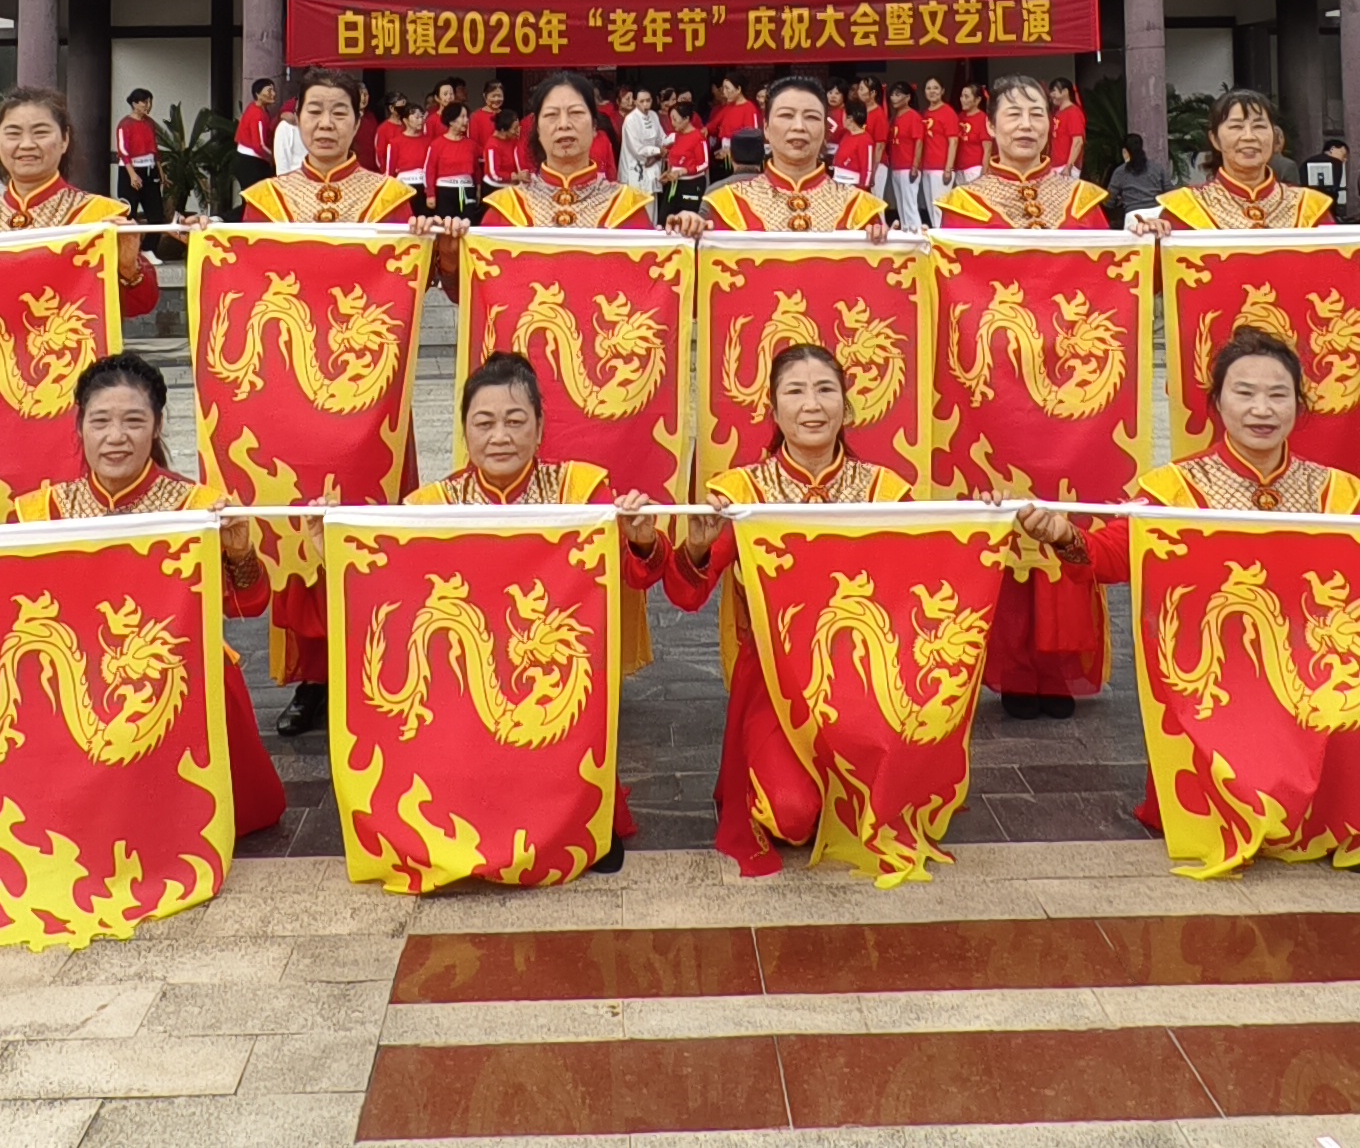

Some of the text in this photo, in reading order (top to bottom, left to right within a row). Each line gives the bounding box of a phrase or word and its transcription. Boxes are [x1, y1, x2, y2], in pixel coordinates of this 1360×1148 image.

[337, 8, 568, 56] 白驹镇2026年
[589, 5, 727, 52] “老年节”
